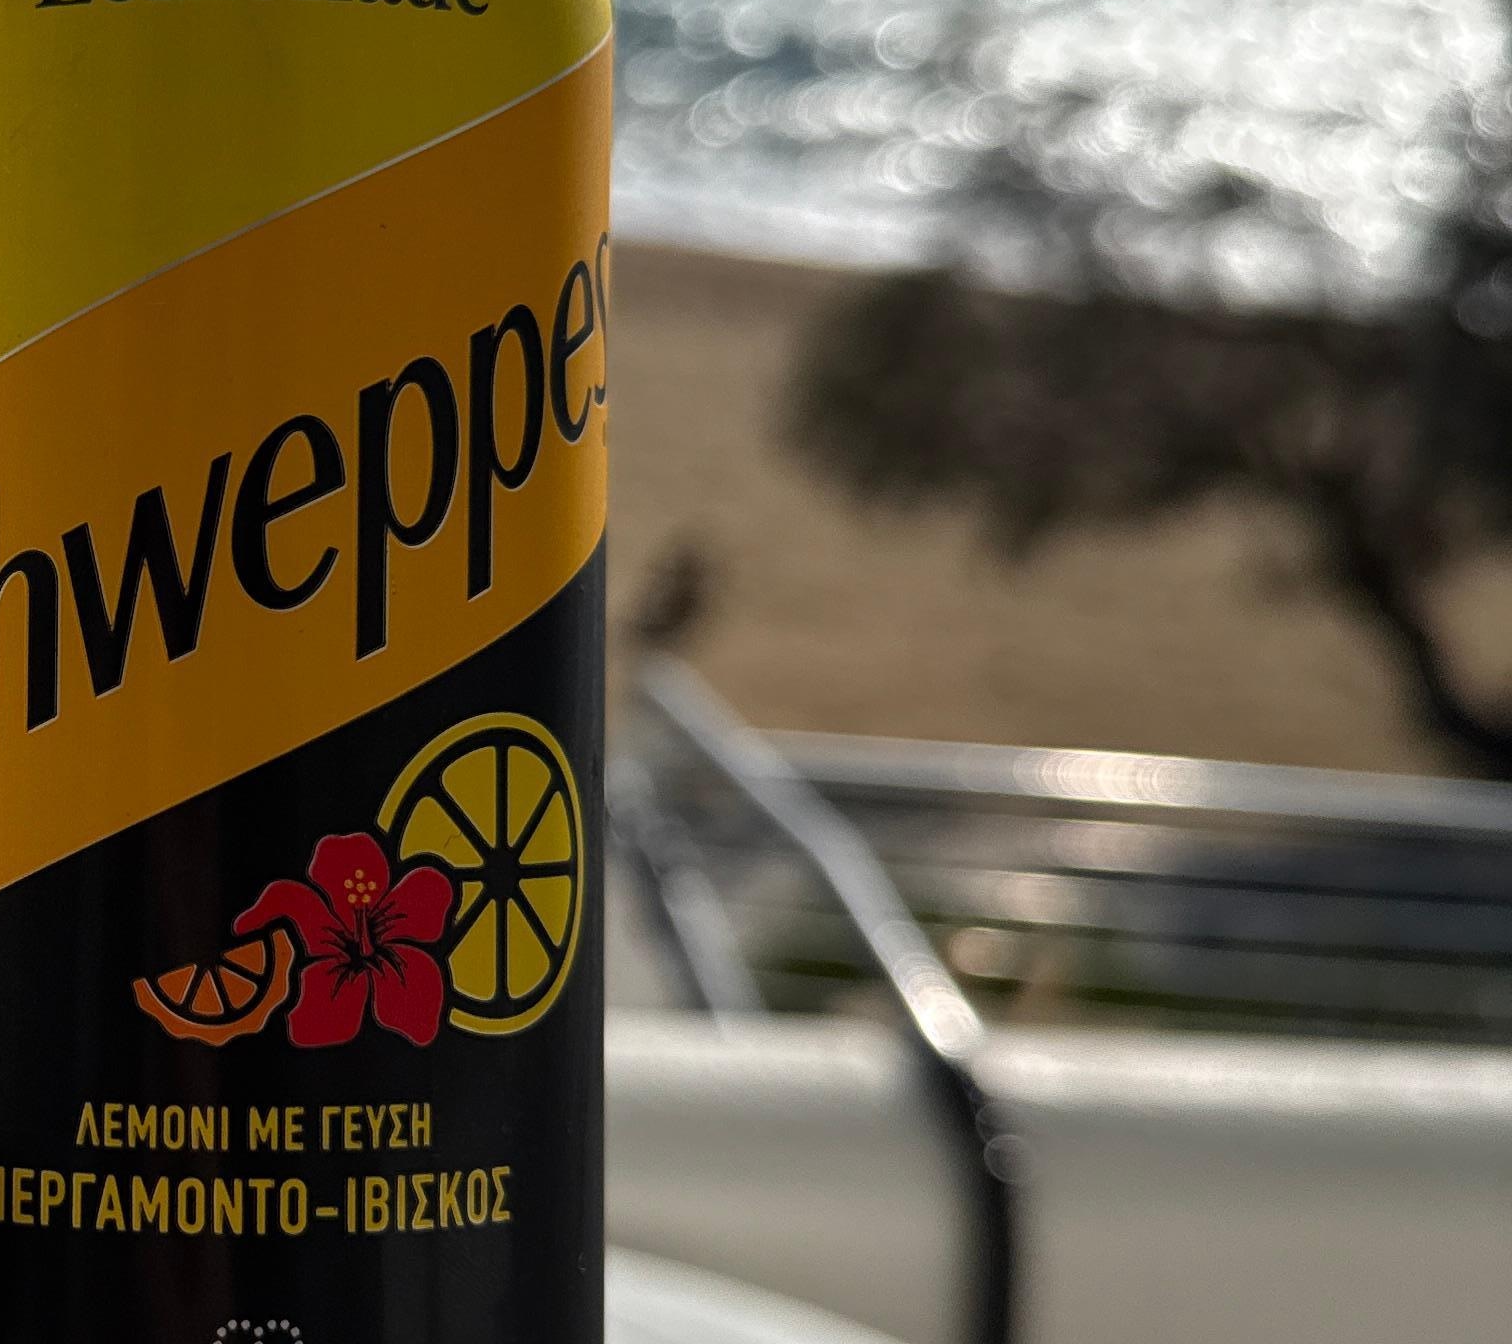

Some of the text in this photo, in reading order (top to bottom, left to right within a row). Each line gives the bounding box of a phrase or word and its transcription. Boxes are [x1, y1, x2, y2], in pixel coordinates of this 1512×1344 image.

[75, 1102, 431, 1152] ΛΕΜΟΝΙ ΜΕ ΓΕΥΣΗ
